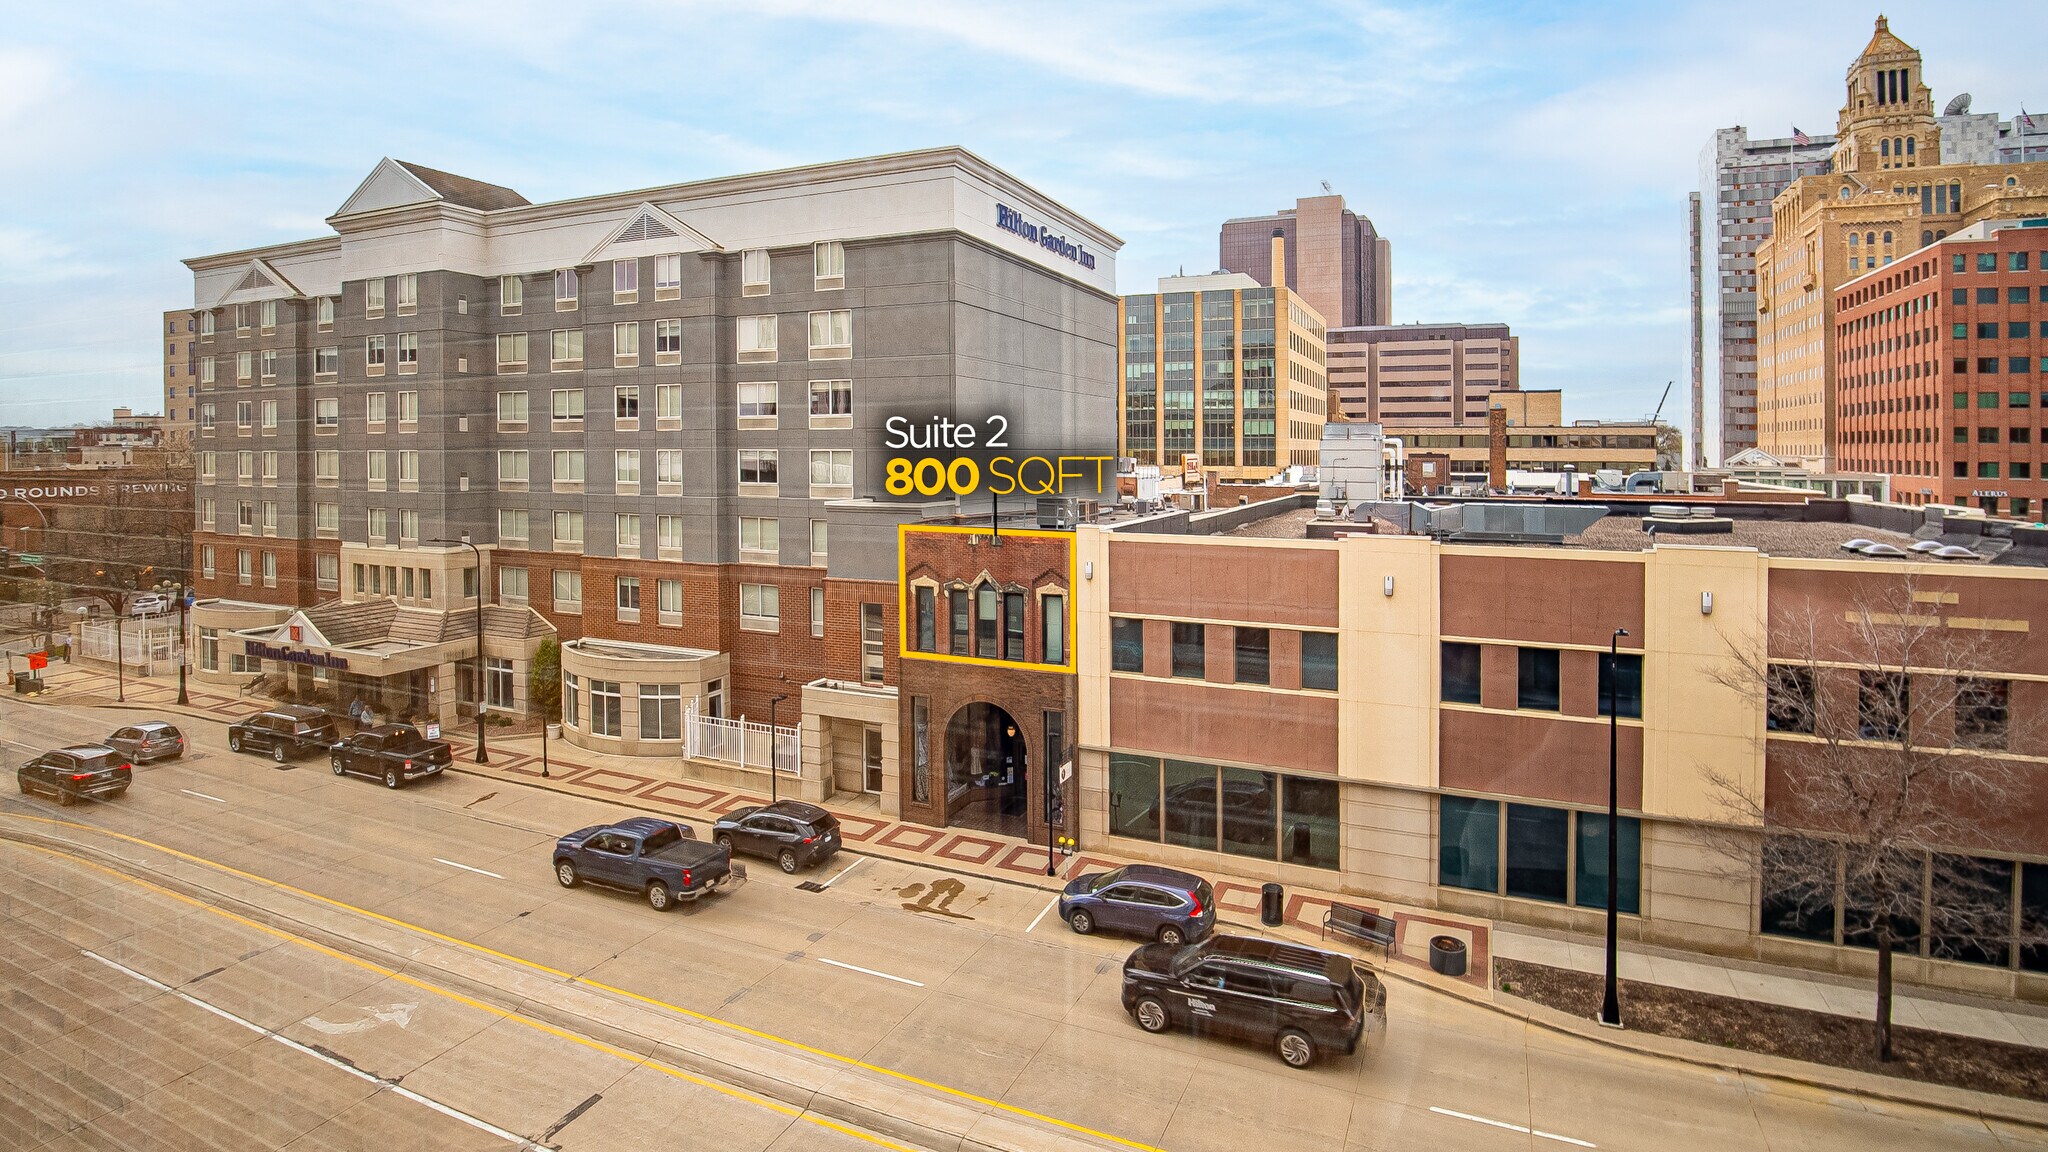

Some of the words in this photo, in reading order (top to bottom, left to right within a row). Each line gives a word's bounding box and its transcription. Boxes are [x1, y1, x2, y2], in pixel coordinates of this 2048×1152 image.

[996, 203, 1038, 243] Hilton
[1039, 226, 1077, 262] Garden
[1077, 244, 1096, 271] Inn
[14, 485, 101, 498] ROUNDS
[1972, 489, 2009, 498] ALERUS
[244, 640, 281, 661] Hilton
[280, 646, 325, 667] Garden
[323, 652, 349, 670] Inn
[1187, 997, 1217, 1011] Hilton
